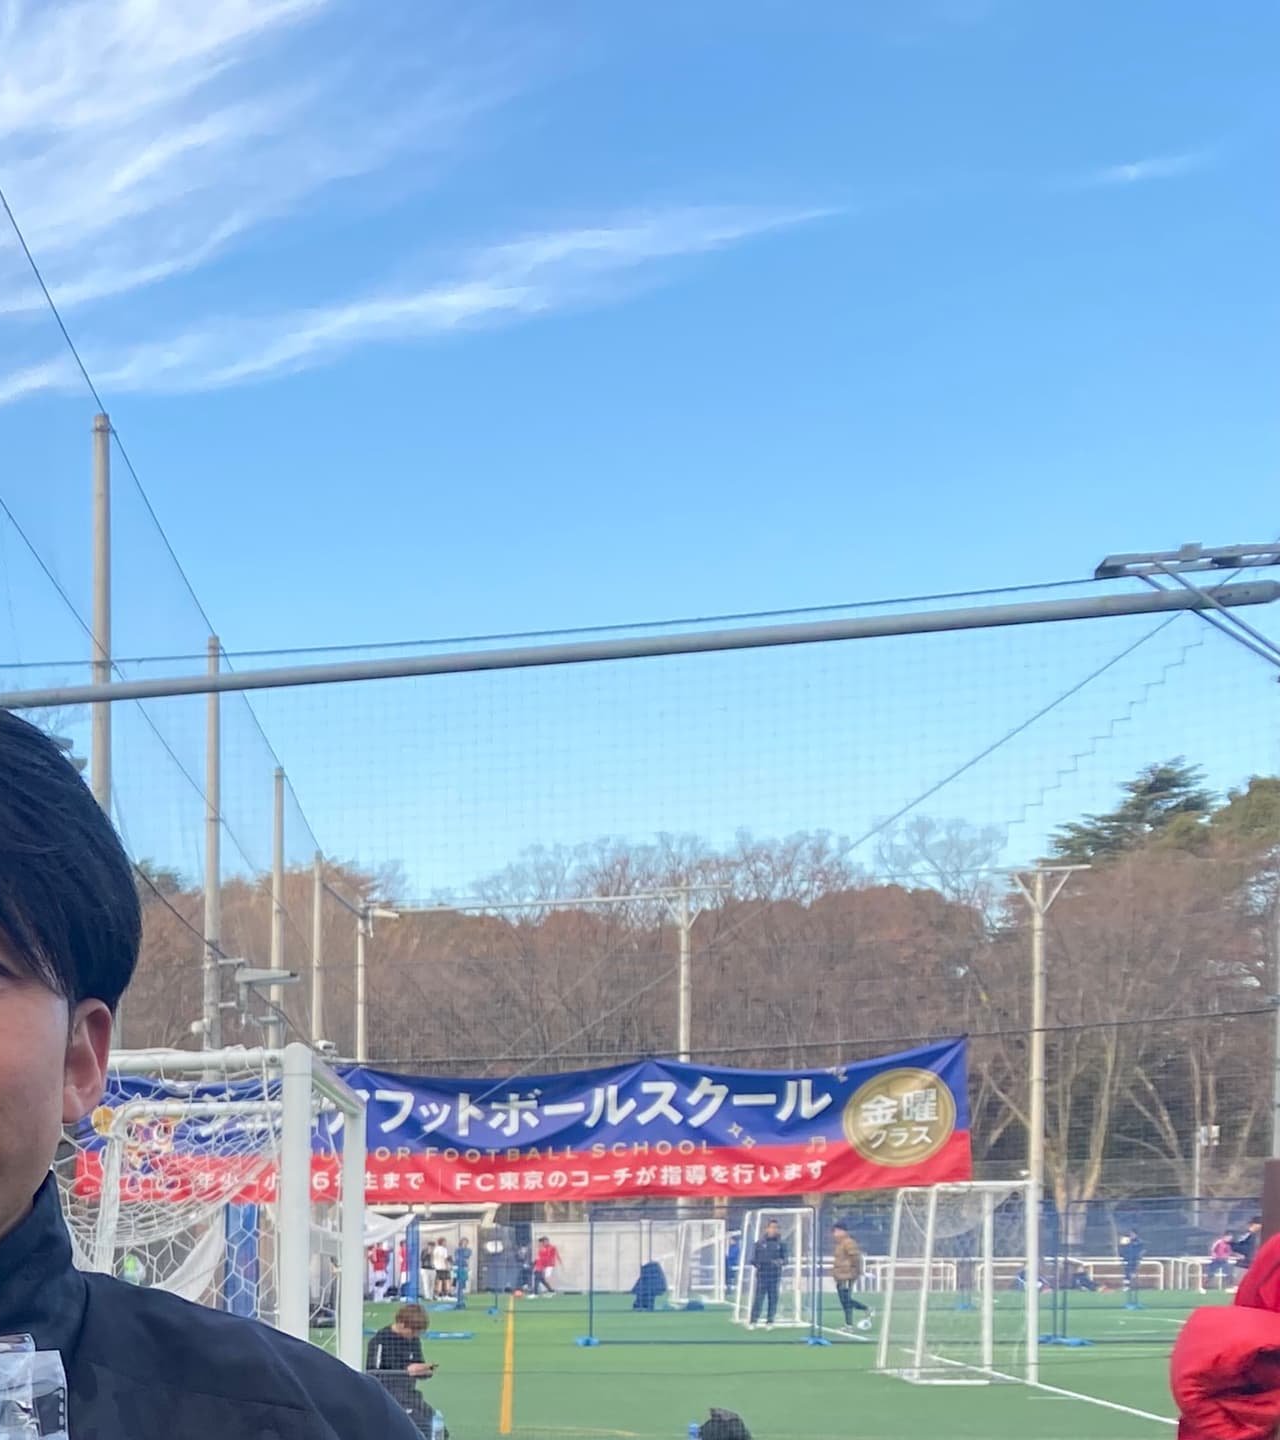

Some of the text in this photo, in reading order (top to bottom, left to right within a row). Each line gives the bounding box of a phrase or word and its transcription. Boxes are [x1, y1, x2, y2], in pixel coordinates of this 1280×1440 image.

[198, 1076, 833, 1137] フットボールスクール
[860, 1088, 939, 1127] 金曜
[425, 1144, 577, 1164] FOOTBALL
[591, 1140, 715, 1160] SCHOOL
[870, 1126, 932, 1149] クラス
